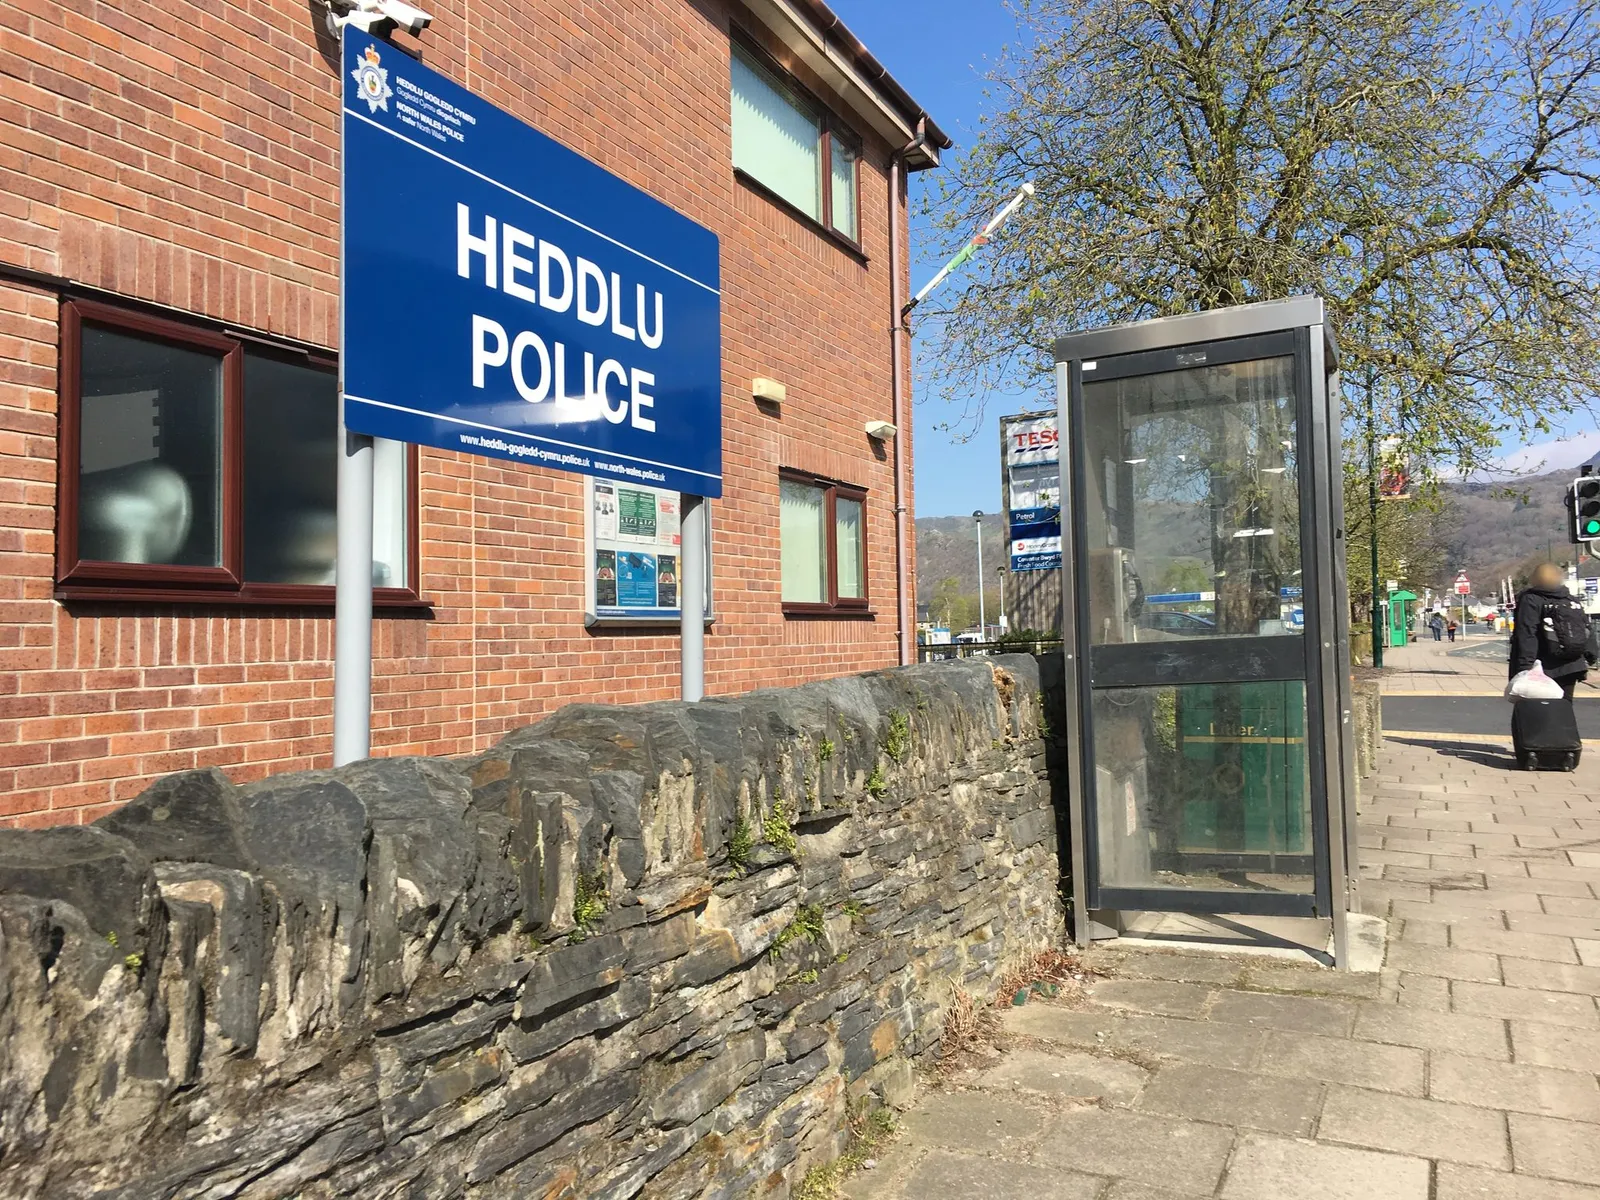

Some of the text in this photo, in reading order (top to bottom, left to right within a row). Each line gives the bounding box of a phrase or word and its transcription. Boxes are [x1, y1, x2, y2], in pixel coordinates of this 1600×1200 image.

[396, 86, 419, 104] Gogledd
[419, 98, 436, 113] Cymru
[396, 75, 423, 97] HEDDLU
[423, 91, 454, 113] GOGLEDD
[454, 108, 476, 125] CYMRU
[396, 101, 464, 142] NORTH WALES POLICE
[396, 112, 447, 142] A safer North Wales
[457, 202, 664, 349] HEDDLU
[472, 313, 656, 433] POLICE
[460, 434, 665, 482] www.heddlu-gogledd-cymru.police.uk www.north-wales.police.uk
[1016, 512, 1035, 520] Petrol
